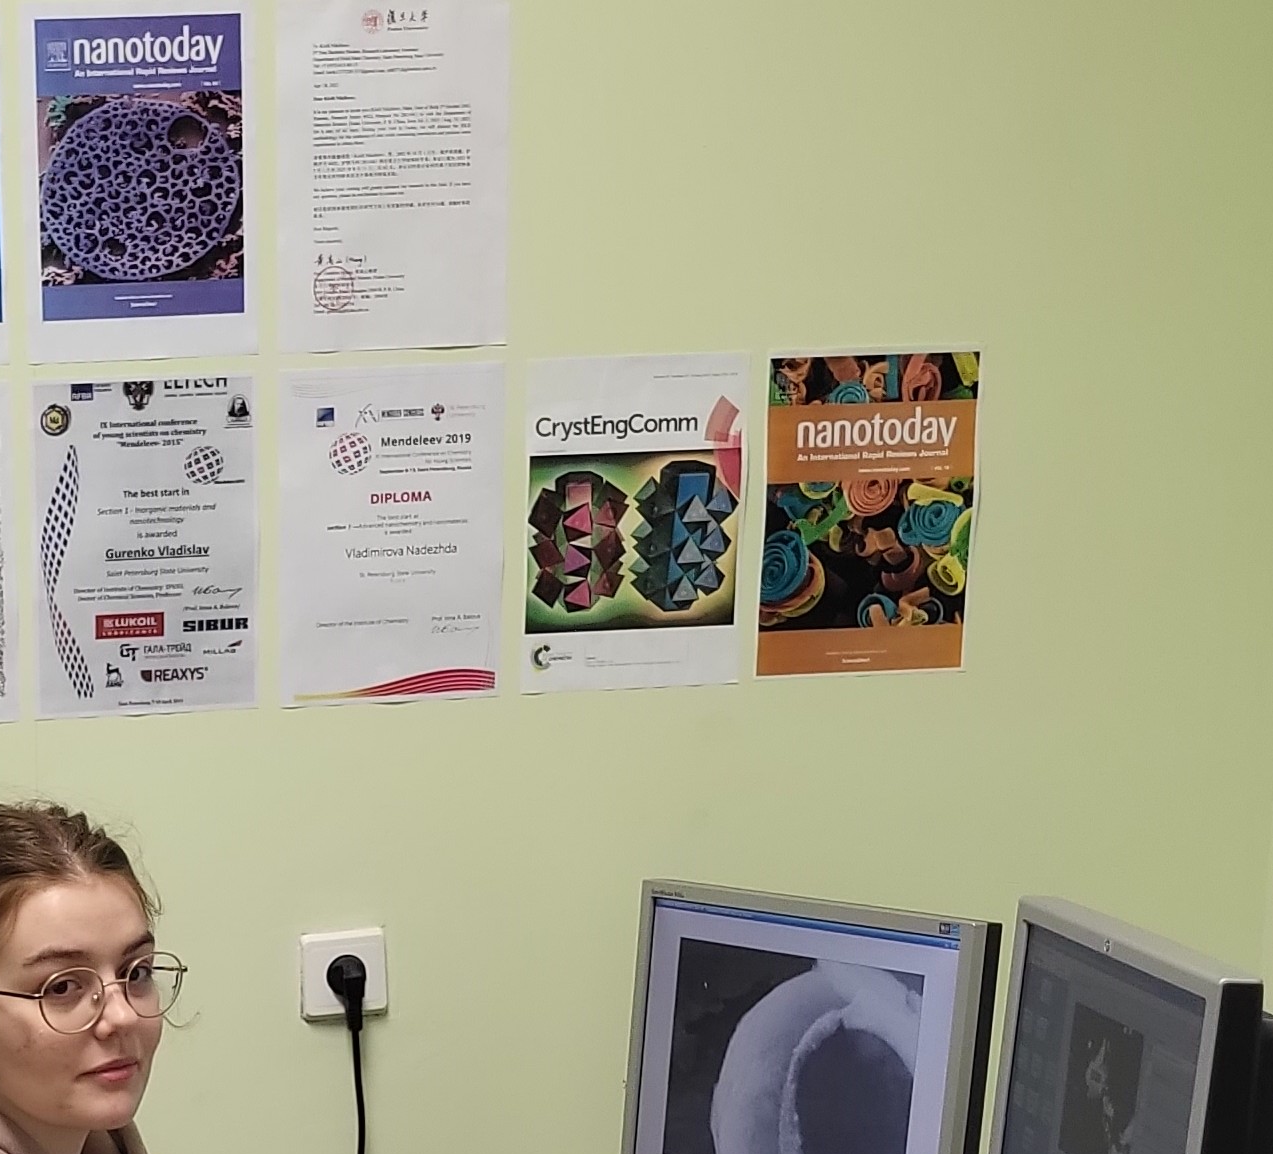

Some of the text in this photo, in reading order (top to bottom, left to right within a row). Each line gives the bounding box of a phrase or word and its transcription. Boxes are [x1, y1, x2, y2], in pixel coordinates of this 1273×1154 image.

[73, 24, 224, 65] nanotoday
[109, 419, 157, 428] International
[158, 418, 198, 427] conference
[535, 413, 699, 442] CrystEngComm
[796, 405, 958, 449] nanotoday
[101, 431, 124, 441] young
[170, 428, 207, 438] chemistry
[381, 433, 472, 447] Mendeleev 2019
[796, 453, 808, 462] An
[809, 451, 861, 461] International
[862, 450, 884, 460] Rapid
[918, 448, 949, 458] Journal
[123, 487, 190, 498] The best start in
[370, 490, 432, 505] DIPLOMA
[97, 506, 124, 516] Section
[134, 505, 167, 515] Inorganic
[168, 503, 201, 512] materials
[202, 503, 216, 511] and
[144, 530, 178, 538] awarded
[105, 545, 210, 560] Gurenko Vladislav
[344, 541, 458, 560] Vladimirova Nadezhda
[106, 570, 123, 578] Saint
[123, 569, 159, 578] Petersburg
[177, 566, 209, 576] University
[114, 616, 158, 628] LUKOIL
[182, 617, 249, 632] SIBUR
